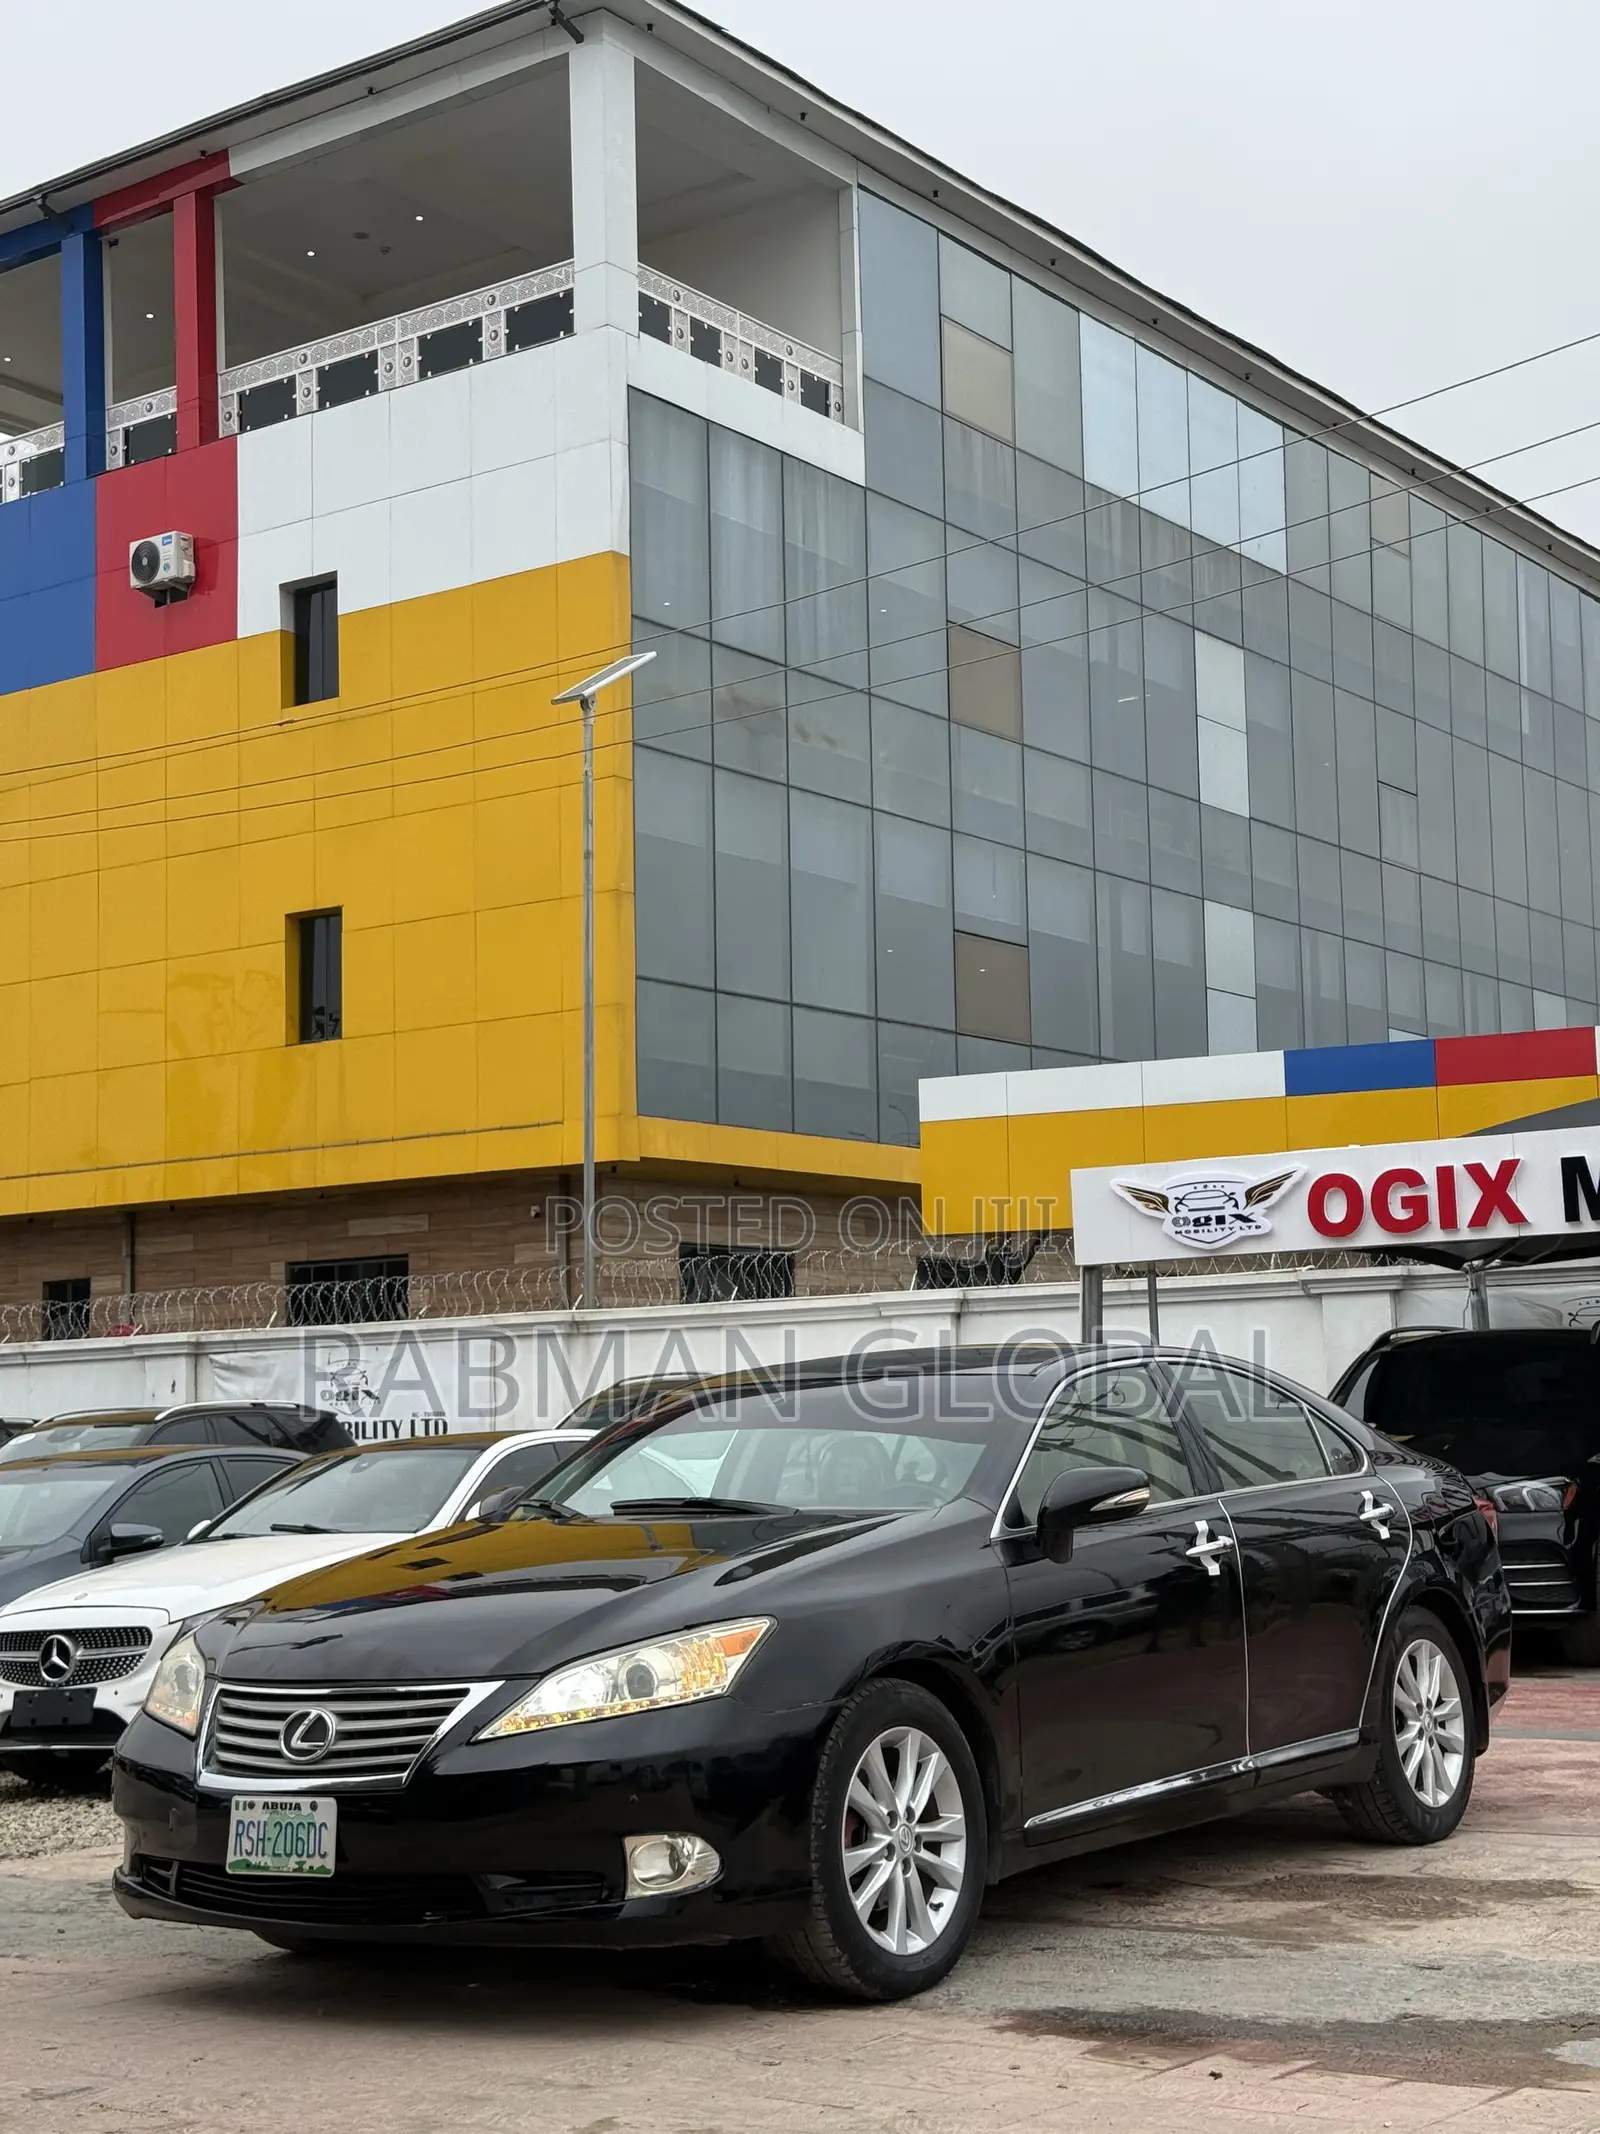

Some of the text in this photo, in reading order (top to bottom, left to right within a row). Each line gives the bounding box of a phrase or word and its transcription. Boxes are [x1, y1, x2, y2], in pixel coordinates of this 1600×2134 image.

[1307, 1158, 1531, 1238] OGIX
[1174, 1226, 1235, 1235] MOBILITY
[262, 1801, 302, 1811] ABUJA
